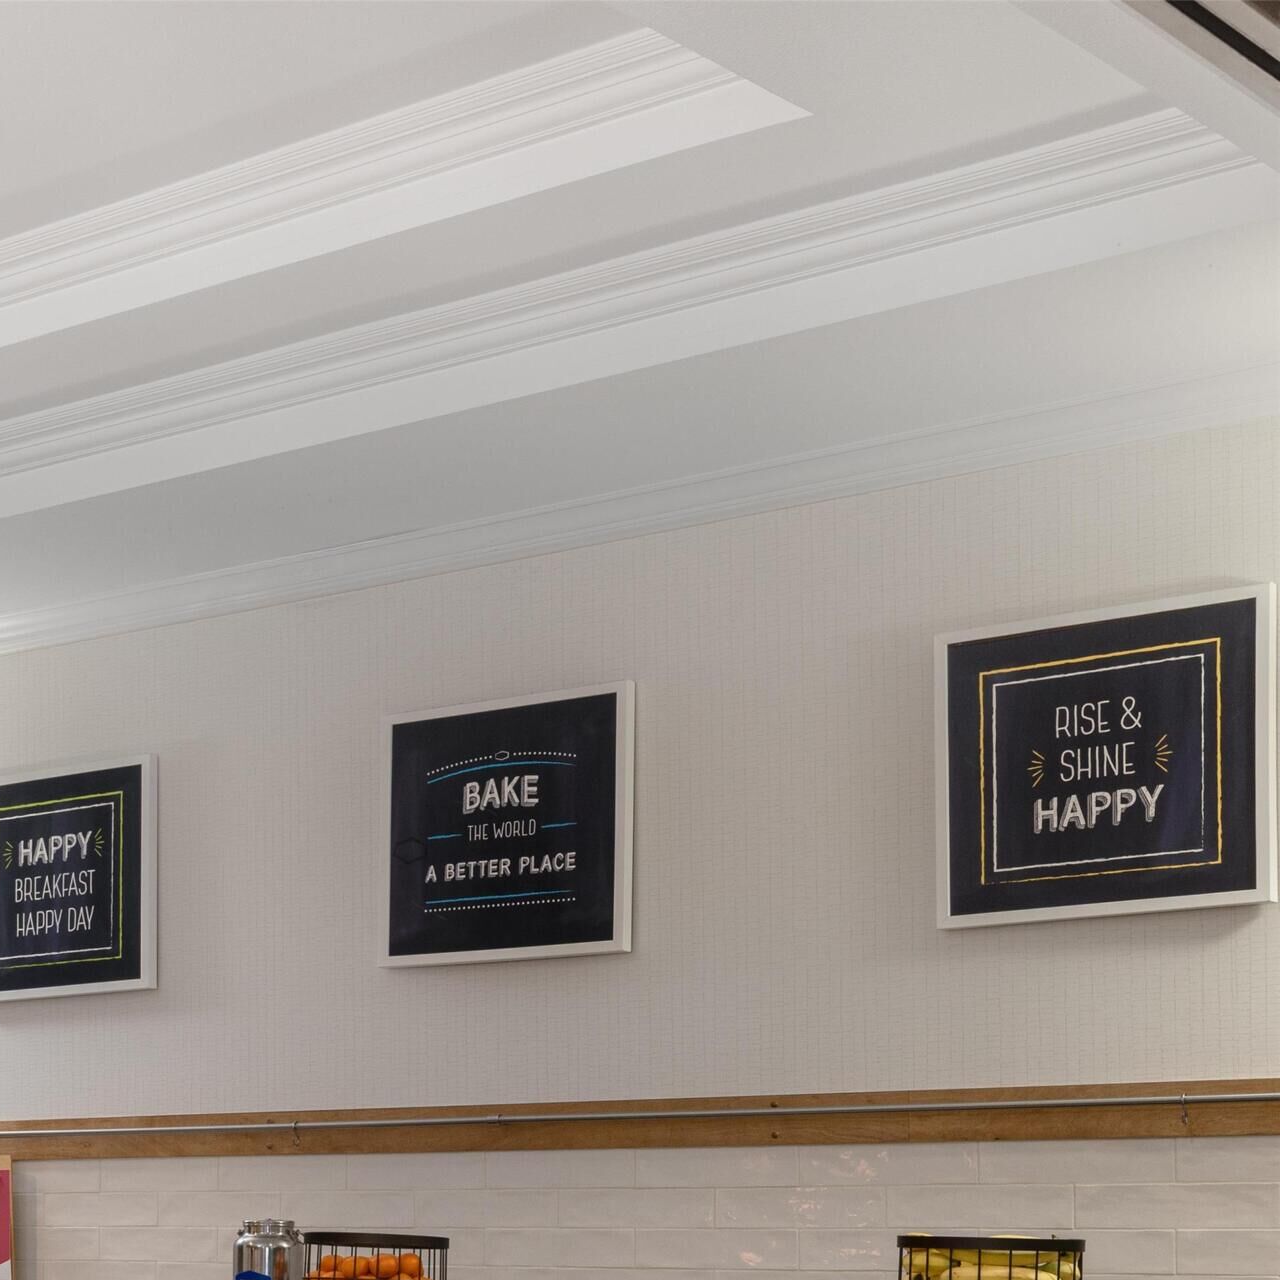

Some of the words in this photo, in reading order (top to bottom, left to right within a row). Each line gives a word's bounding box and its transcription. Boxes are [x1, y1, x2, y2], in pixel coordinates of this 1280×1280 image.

[1056, 700, 1110, 738] RISE
[1120, 696, 1142, 730] &
[1060, 742, 1136, 782] SHINE
[463, 775, 539, 814] BAKE
[1033, 784, 1164, 834] HAPPY
[467, 823, 490, 842] THE
[493, 818, 537, 840] WORLD
[18, 831, 93, 867] HAPPY
[425, 864, 438, 883] A
[444, 858, 512, 881] BETTER
[518, 851, 577, 875] PLACE
[15, 869, 97, 903] BREAKFAST
[16, 909, 63, 938] HAPPY
[67, 905, 95, 933] DAY
